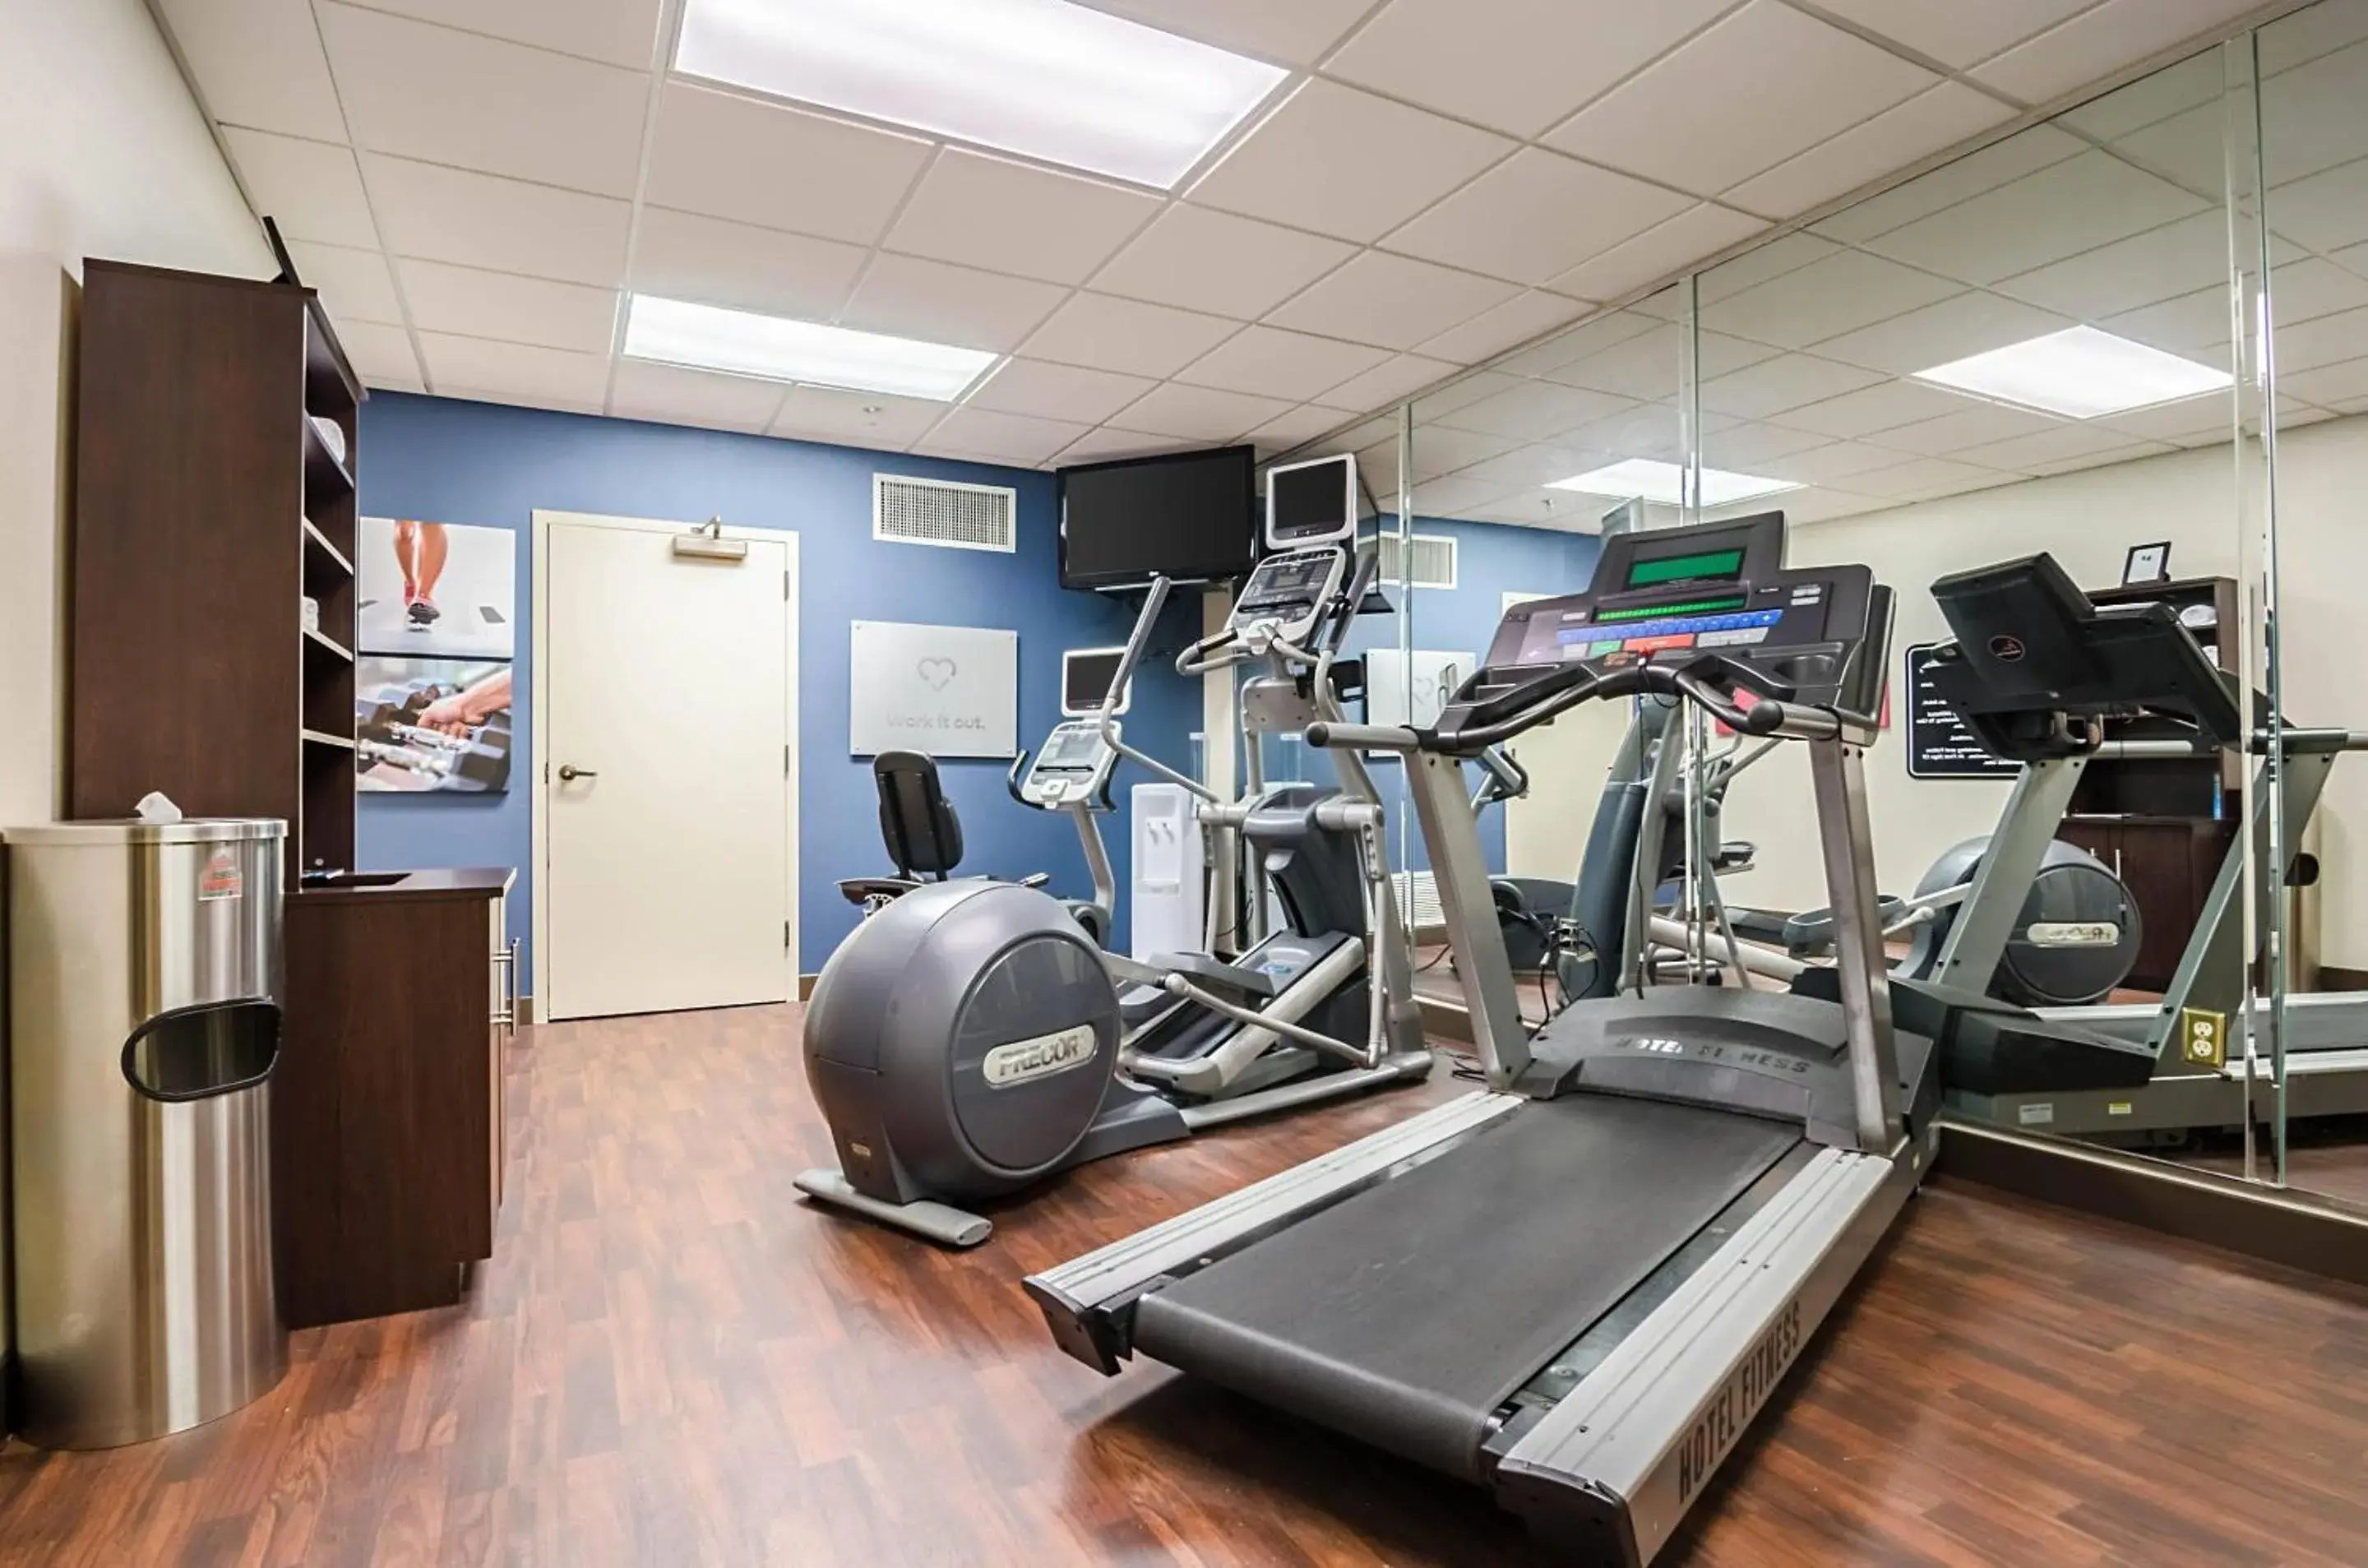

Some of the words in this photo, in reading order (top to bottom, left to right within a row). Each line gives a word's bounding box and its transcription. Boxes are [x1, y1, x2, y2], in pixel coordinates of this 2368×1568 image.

[999, 1034, 1079, 1076] PRECOR
[1696, 1045, 1812, 1073] FINESS
[1679, 1385, 1736, 1505] HOTEL
[1741, 1300, 1801, 1419] FITNESS
